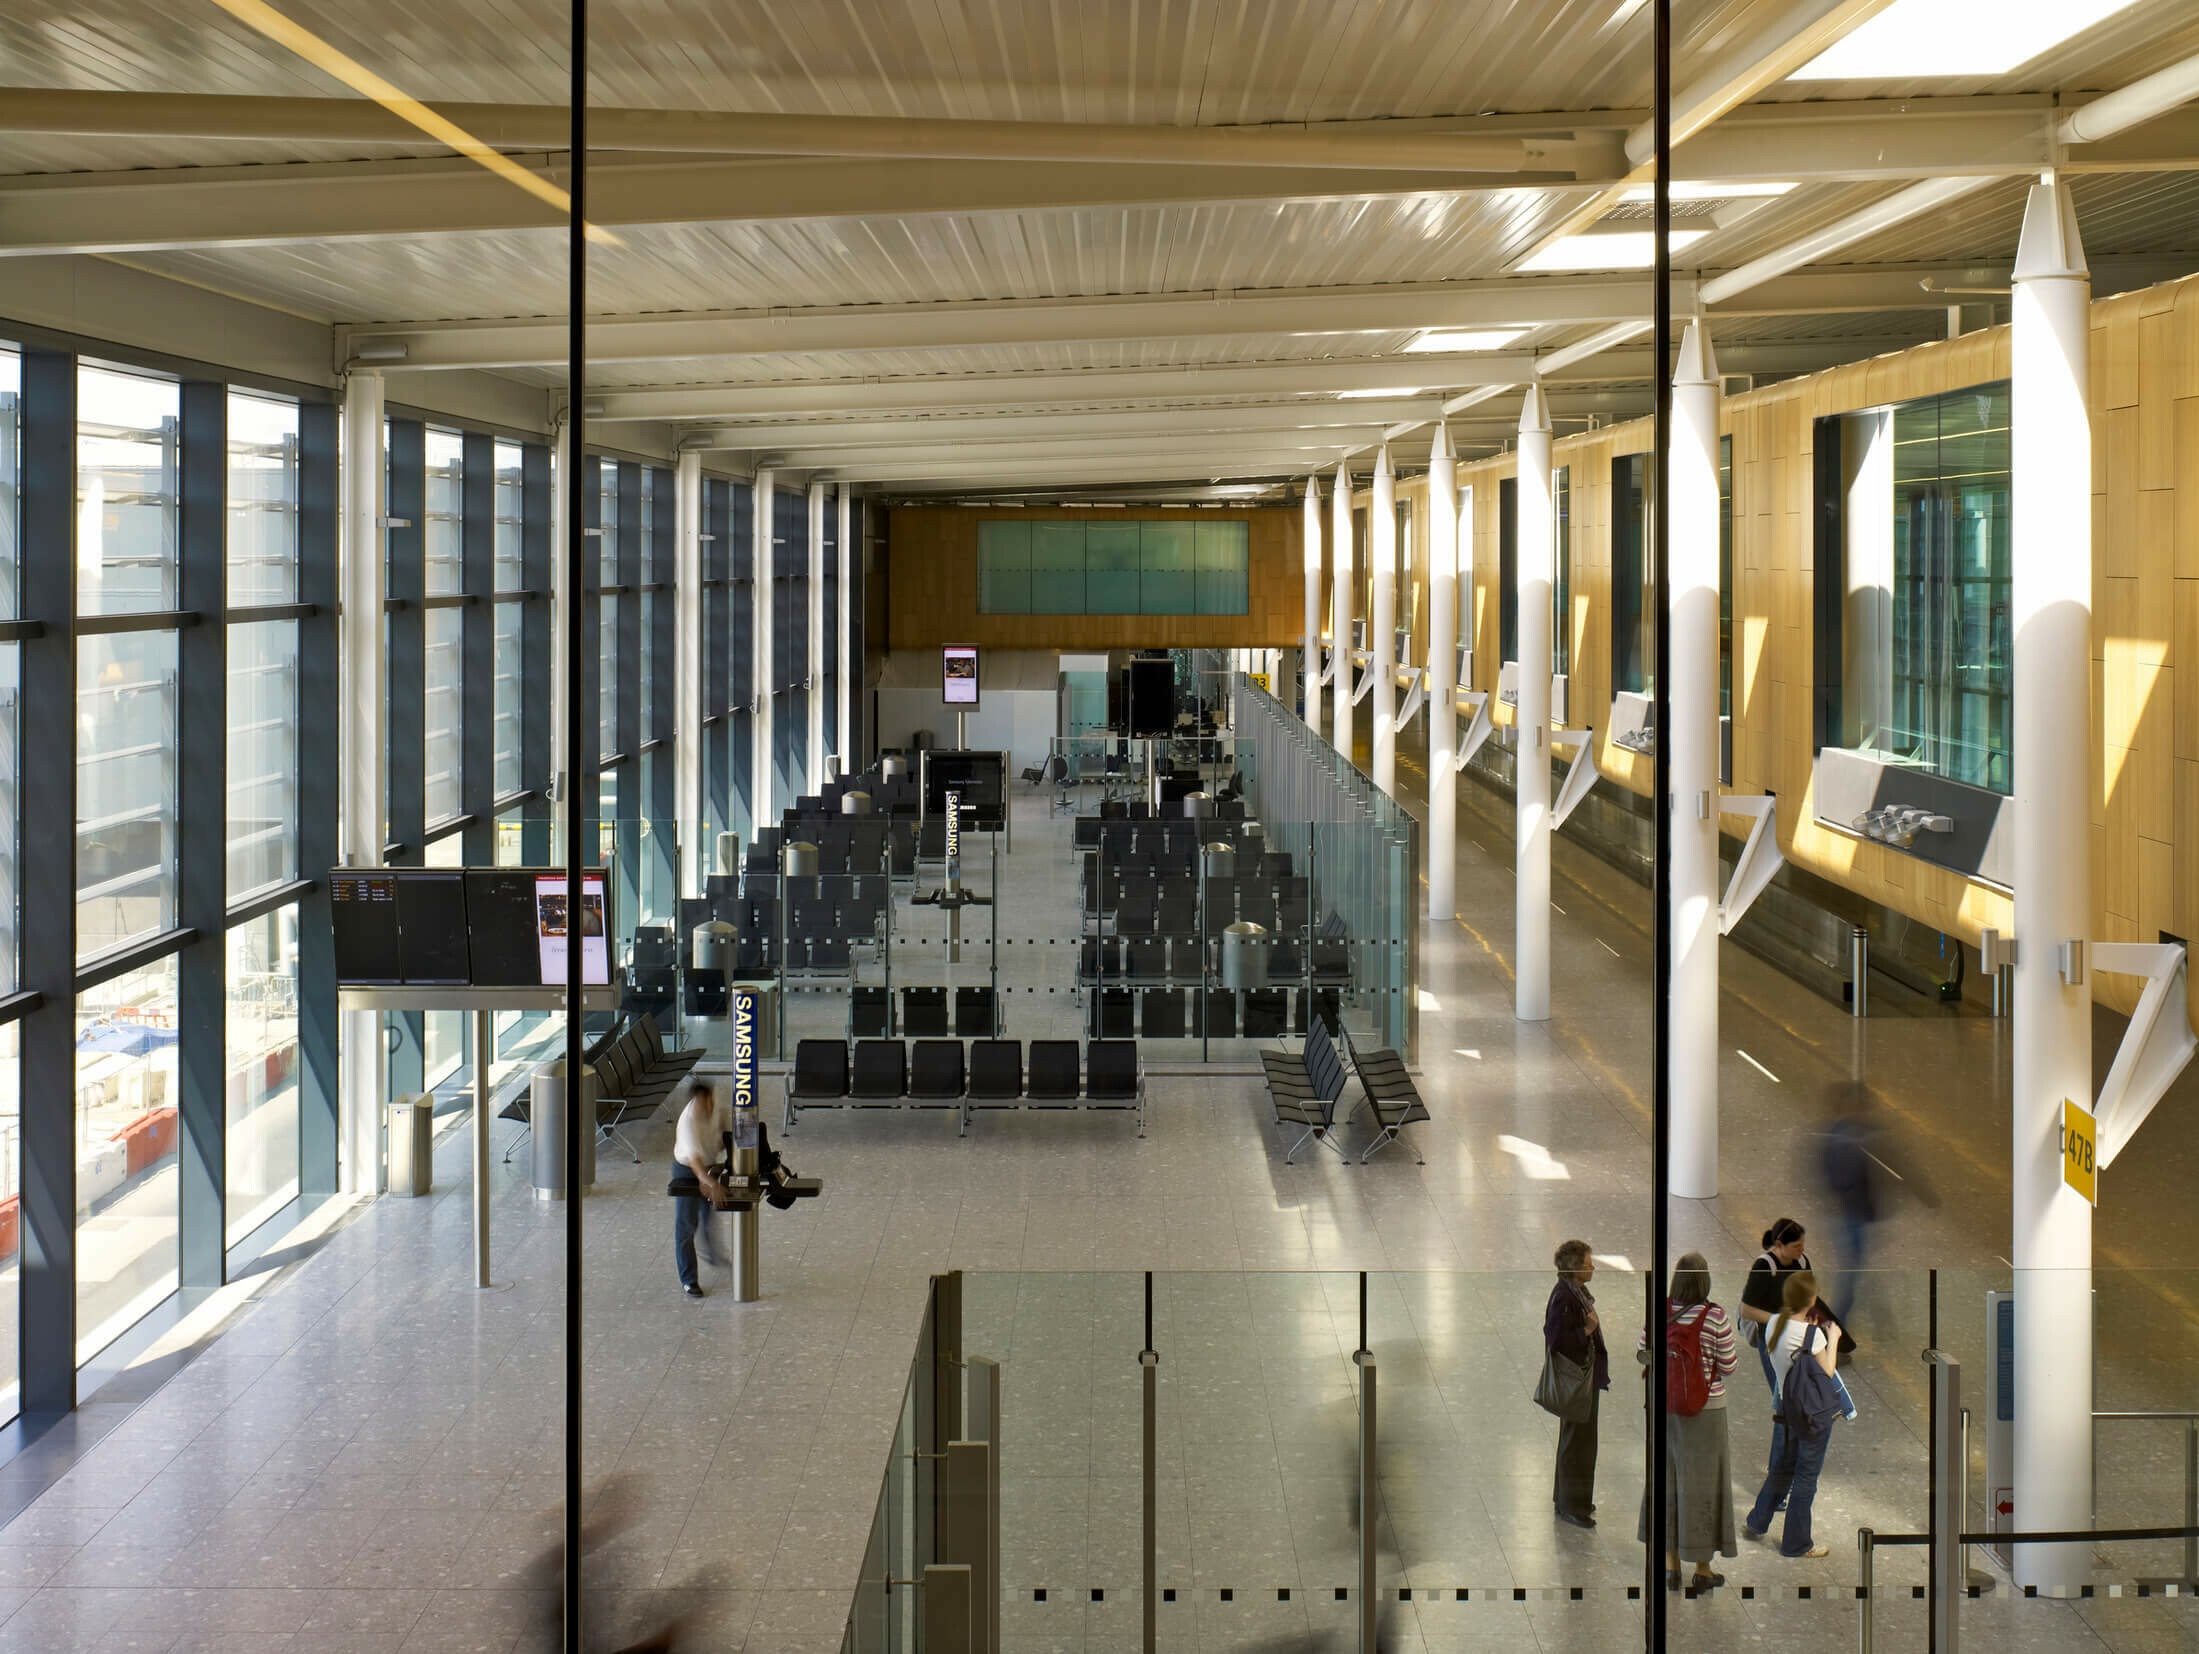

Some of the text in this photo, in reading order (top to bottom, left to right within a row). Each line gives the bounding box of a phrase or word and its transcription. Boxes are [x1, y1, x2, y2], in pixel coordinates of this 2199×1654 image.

[948, 795, 958, 856] SAMSUNG
[735, 995, 752, 1106] SAMSUNG
[2068, 1129, 2093, 1175] 47B
